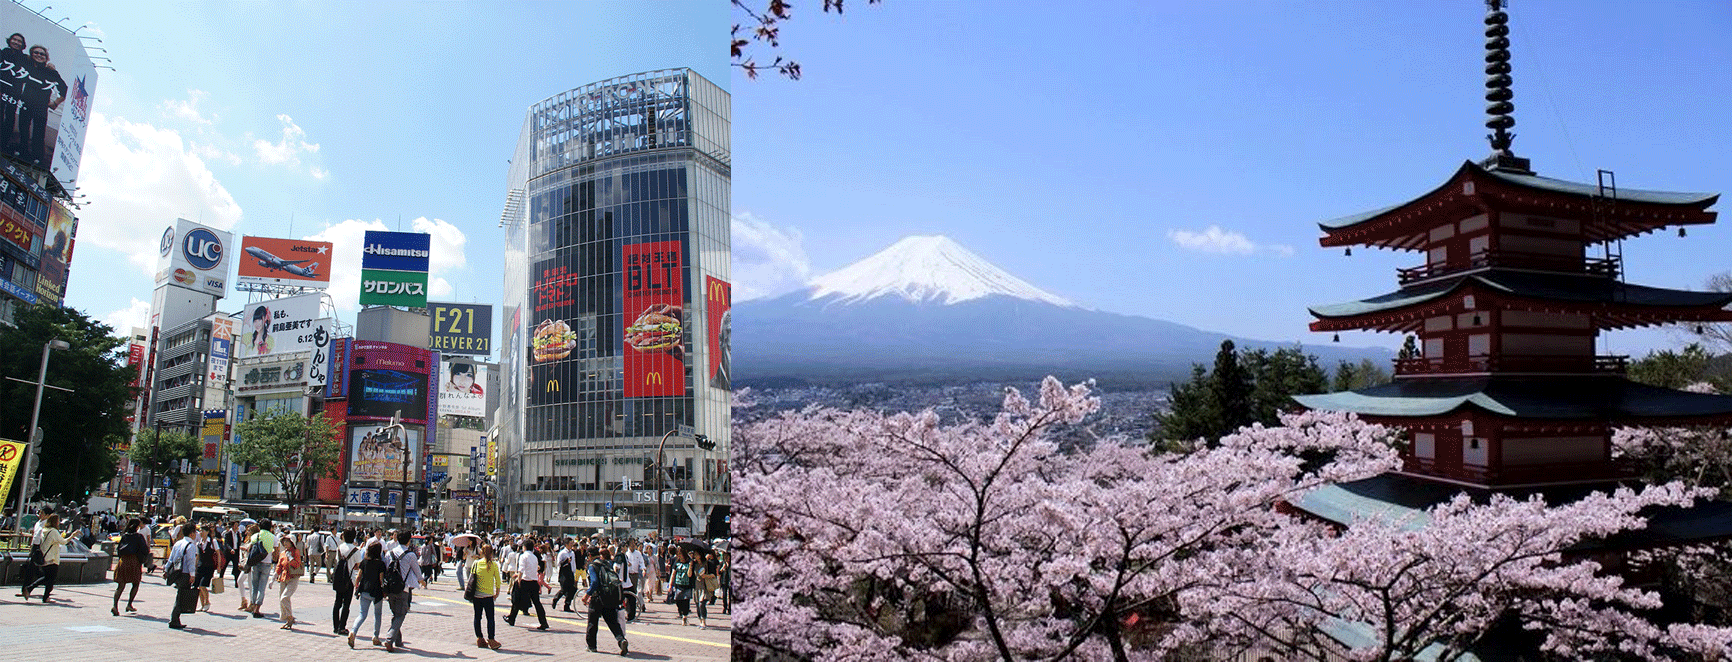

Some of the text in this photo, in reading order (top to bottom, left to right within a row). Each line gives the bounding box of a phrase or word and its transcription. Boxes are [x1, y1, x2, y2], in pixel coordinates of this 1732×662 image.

[0, 60, 60, 98] スターズ
[290, 245, 318, 253] Jetstar
[364, 244, 429, 258] Hisamitsu
[38, 273, 61, 293] Linked
[628, 263, 677, 290] BLT
[207, 280, 223, 289] VISA
[363, 280, 425, 295] サロンパス
[35, 284, 59, 303] Horizon
[434, 307, 474, 334] F21
[298, 334, 313, 343] 6.12
[477, 338, 489, 351] 21
[310, 324, 329, 384] もんじゃ
[555, 457, 608, 467] STARBUCKS
